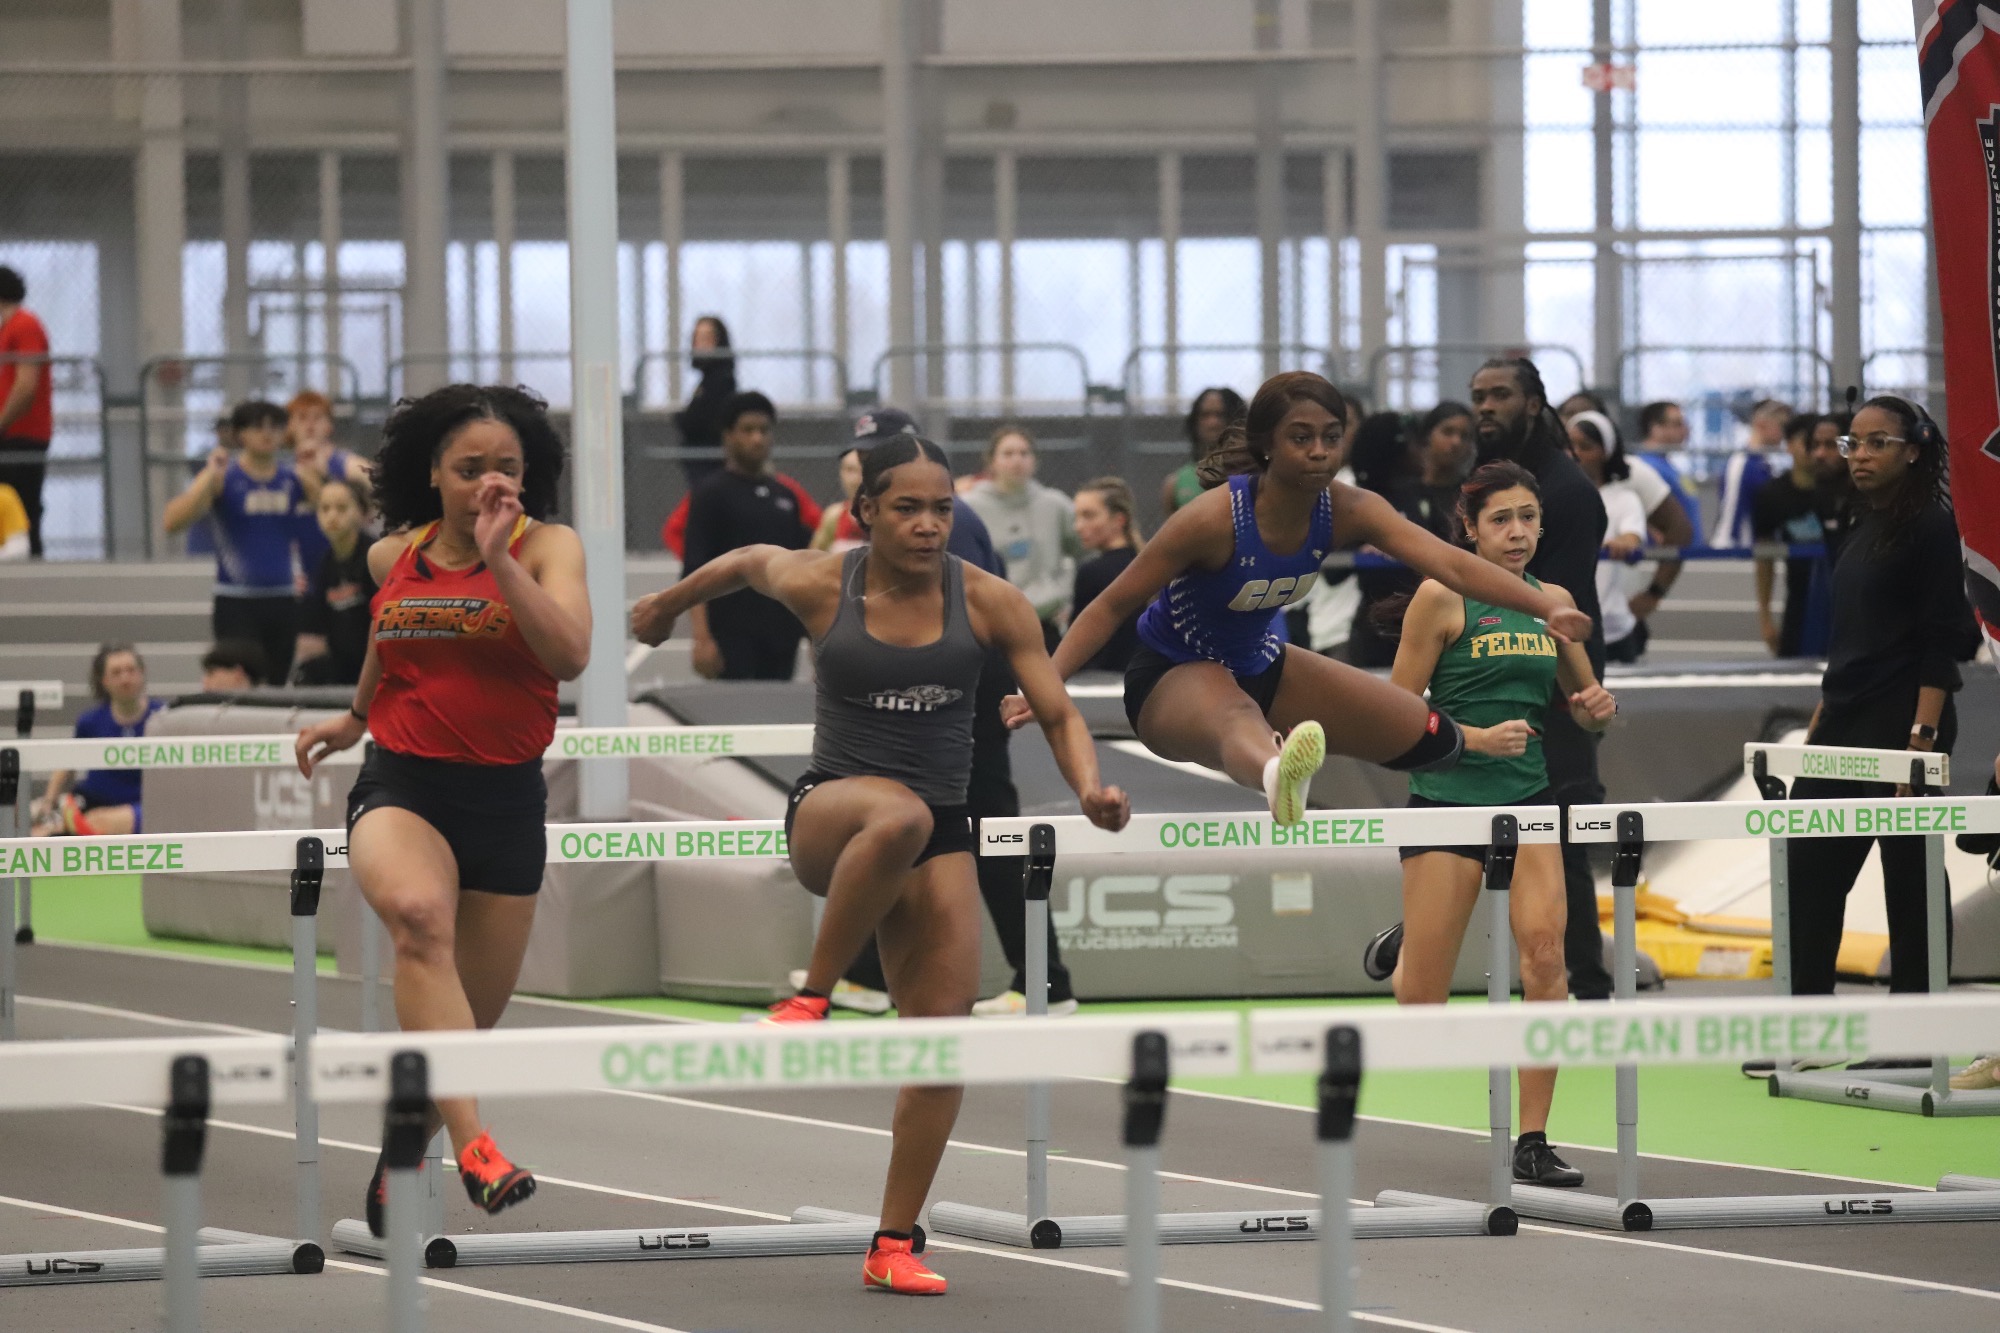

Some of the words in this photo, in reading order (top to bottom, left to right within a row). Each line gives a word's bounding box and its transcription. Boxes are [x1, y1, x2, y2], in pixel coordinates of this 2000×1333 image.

[104, 746, 186, 766] OCEAN
[191, 743, 281, 764] BREEZE
[563, 736, 641, 755] OCEAN
[648, 734, 734, 753] BREEZE
[1803, 752, 1837, 775] OCEAN
[1839, 754, 1880, 778] BREEZE
[1518, 822, 1555, 831] UCS
[1576, 821, 1612, 831] UCS
[1746, 808, 1845, 836] OCEAN
[1855, 806, 1967, 833] BREEZE
[987, 834, 1024, 844] UCS
[1160, 820, 1262, 848] OCEAN
[1271, 818, 1385, 846] BREEZE
[325, 846, 349, 856] UC
[561, 831, 665, 859] OCEAN
[676, 830, 790, 857] BREEZE
[63, 843, 184, 872] BREEZE
[1523, 1015, 1682, 1059] OCEAN
[1697, 1012, 1868, 1054] BREEZE
[601, 1042, 765, 1085] OCEAN
[780, 1036, 961, 1080] BREEZE
[1845, 1085, 1871, 1100] UCS
[1825, 1199, 1893, 1215] UCS
[1239, 1216, 1310, 1233] UCS
[638, 1233, 711, 1250] UCS
